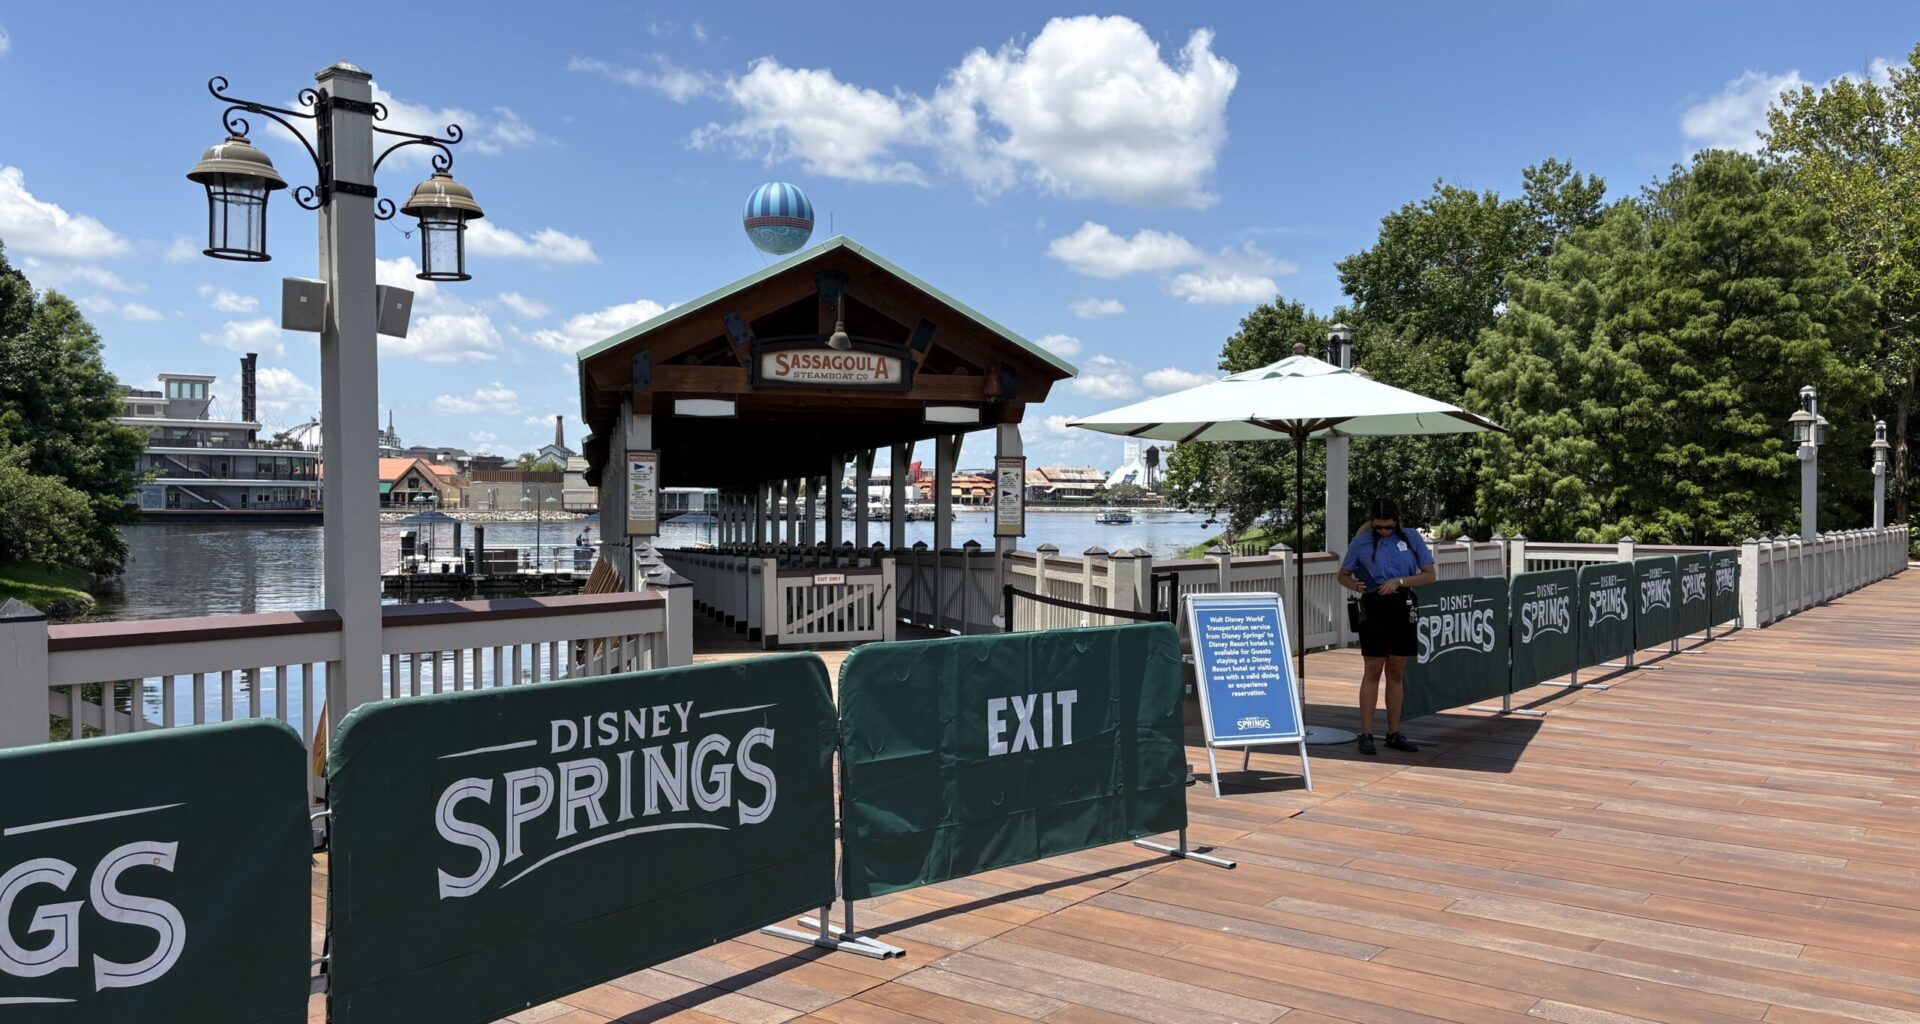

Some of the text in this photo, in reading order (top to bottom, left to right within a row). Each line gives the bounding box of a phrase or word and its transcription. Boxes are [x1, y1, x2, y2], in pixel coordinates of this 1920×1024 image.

[775, 353, 889, 379] SASSAGOULA
[793, 371, 854, 381] STEAMBOAT
[1600, 574, 1617, 588] DISNEY
[1536, 583, 1558, 598] DISNEY
[1641, 578, 1672, 614] SPRINGS
[1440, 594, 1474, 611] DISNEY
[1588, 586, 1628, 628] SPRINGS
[1206, 624, 1249, 632] Transportation
[1225, 616, 1244, 624] Disney
[1521, 595, 1570, 644] SPRINGS
[1222, 632, 1241, 640] Disney
[1417, 608, 1496, 664] SPRINGS
[1261, 672, 1280, 680] dining
[550, 701, 694, 754] DISNEY
[987, 689, 1078, 757] EXIT
[1237, 720, 1271, 730] SPRINGS
[435, 727, 777, 900] SPRINGS
